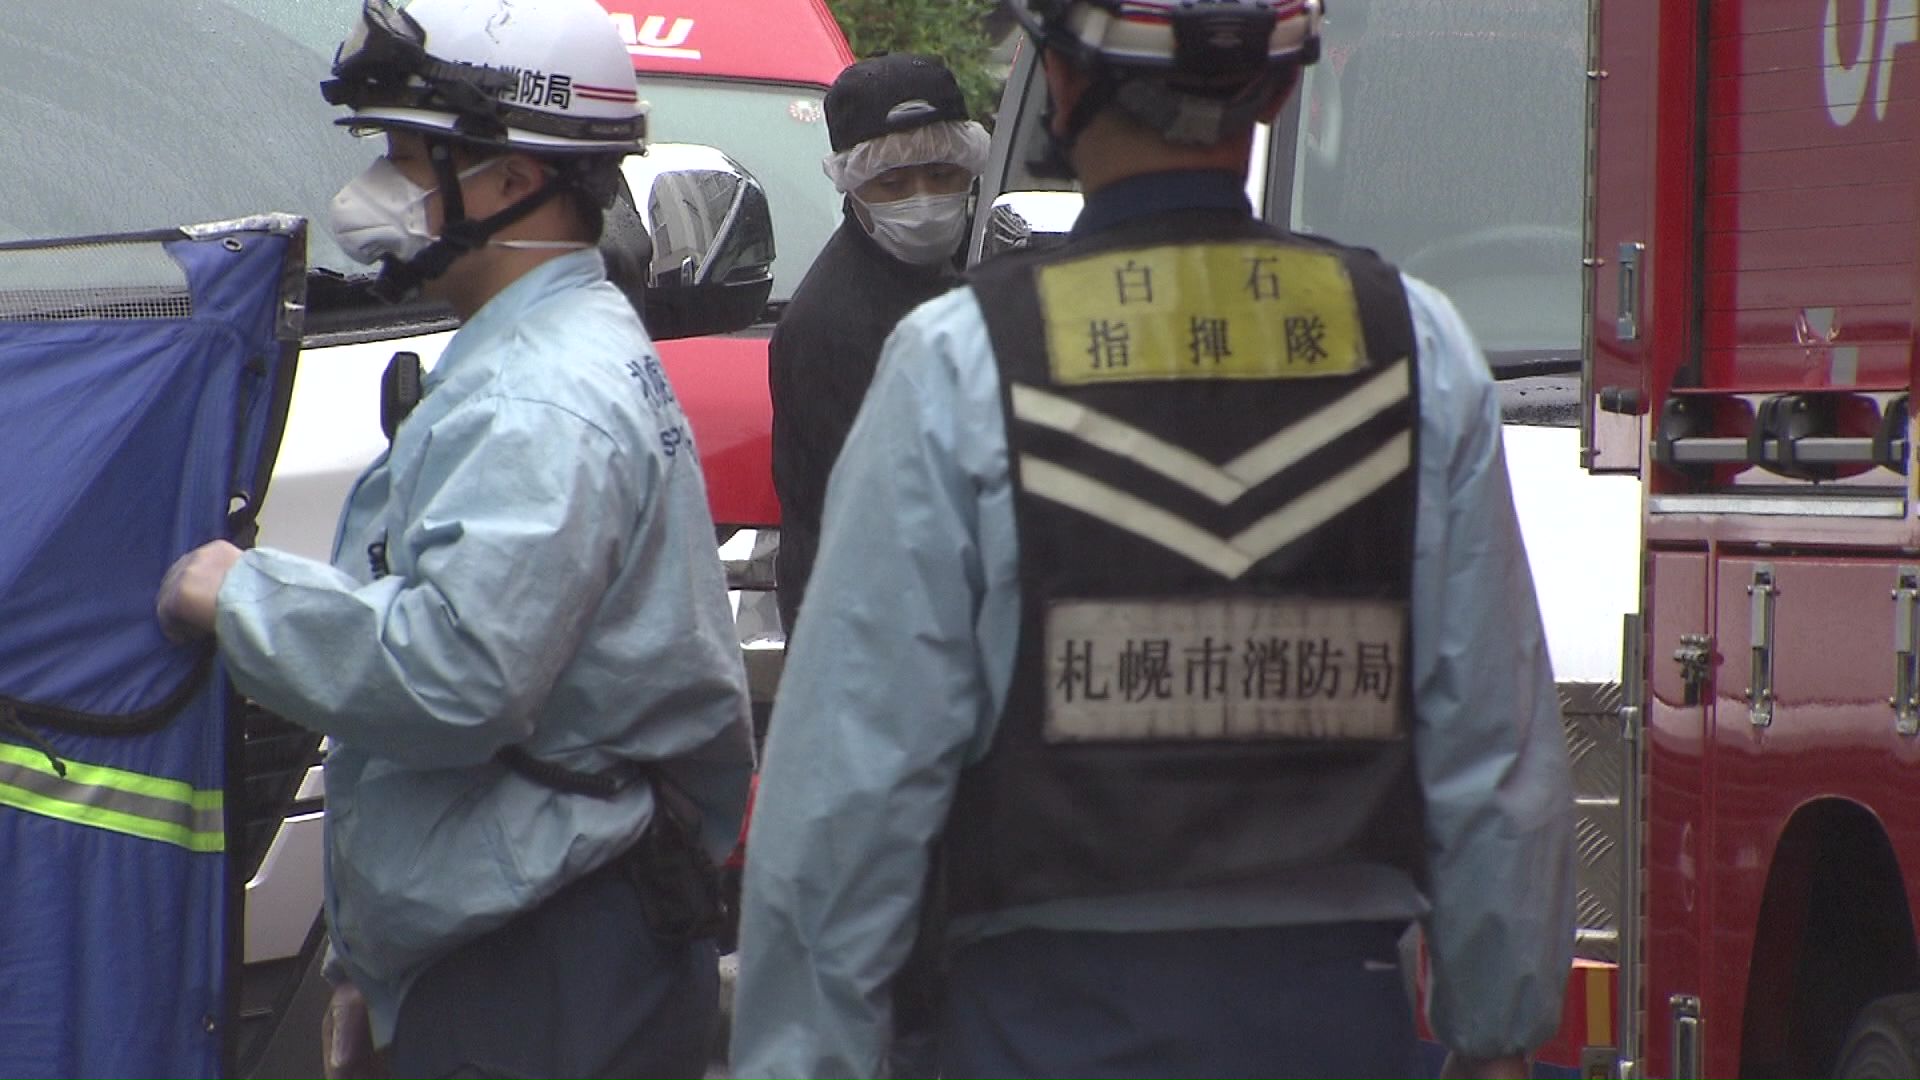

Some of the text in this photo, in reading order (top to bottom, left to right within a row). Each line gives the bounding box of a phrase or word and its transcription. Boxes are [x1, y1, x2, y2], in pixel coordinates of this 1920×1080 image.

[1115, 256, 1280, 304] 白石
[1087, 315, 1328, 368] 指揮隊
[1056, 637, 1394, 702] 札幌市消防局
